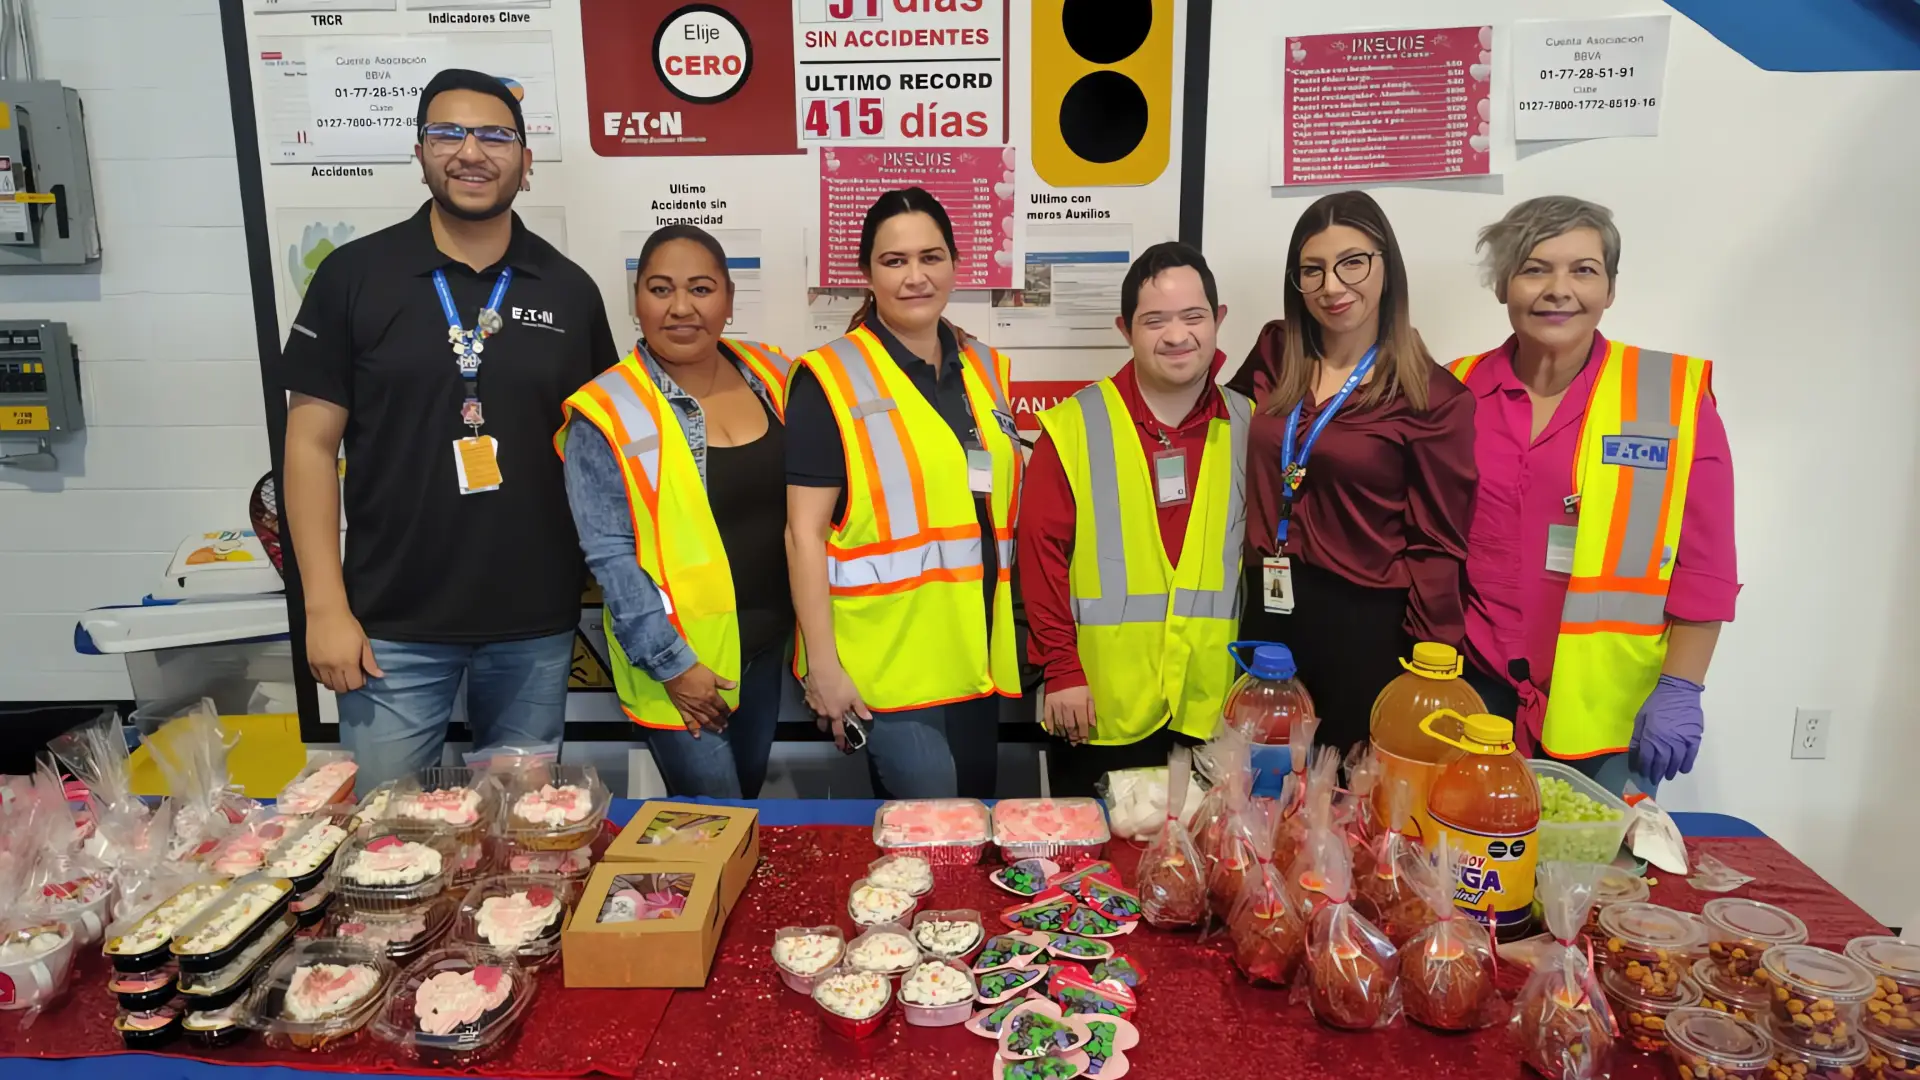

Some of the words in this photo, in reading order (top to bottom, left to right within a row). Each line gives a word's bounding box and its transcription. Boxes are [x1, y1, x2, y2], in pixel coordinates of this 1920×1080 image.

[310, 14, 343, 26] TRCR
[428, 12, 496, 24] Indicadores
[499, 11, 531, 23] Clave
[684, 24, 720, 44] Elije
[805, 30, 837, 48] SIN
[843, 28, 989, 47] ACCIDENTES
[1352, 35, 1425, 53] PRECIOS
[1545, 37, 1582, 47] Cuenta
[1573, 51, 1602, 62] BBVA
[665, 54, 742, 76] CERO
[1540, 66, 1634, 80] 01-77-28-51-91
[805, 74, 891, 91] ULTIMO
[899, 73, 993, 90] RECORD
[1519, 98, 1656, 111] 0127-7800-1772-8519-16
[603, 111, 683, 136] EATON
[804, 98, 883, 138] 415
[899, 102, 989, 139] días
[883, 152, 952, 167] PRECIOS
[311, 166, 374, 177] Accidentes
[669, 184, 706, 194] Ultimo
[651, 199, 707, 210] Accidente
[710, 198, 727, 209] sin
[1030, 193, 1068, 204] Ultimo
[1071, 195, 1091, 203] con
[1065, 208, 1111, 219] Auxilios
[511, 306, 554, 325] EATON
[1605, 442, 1668, 462] EATON
